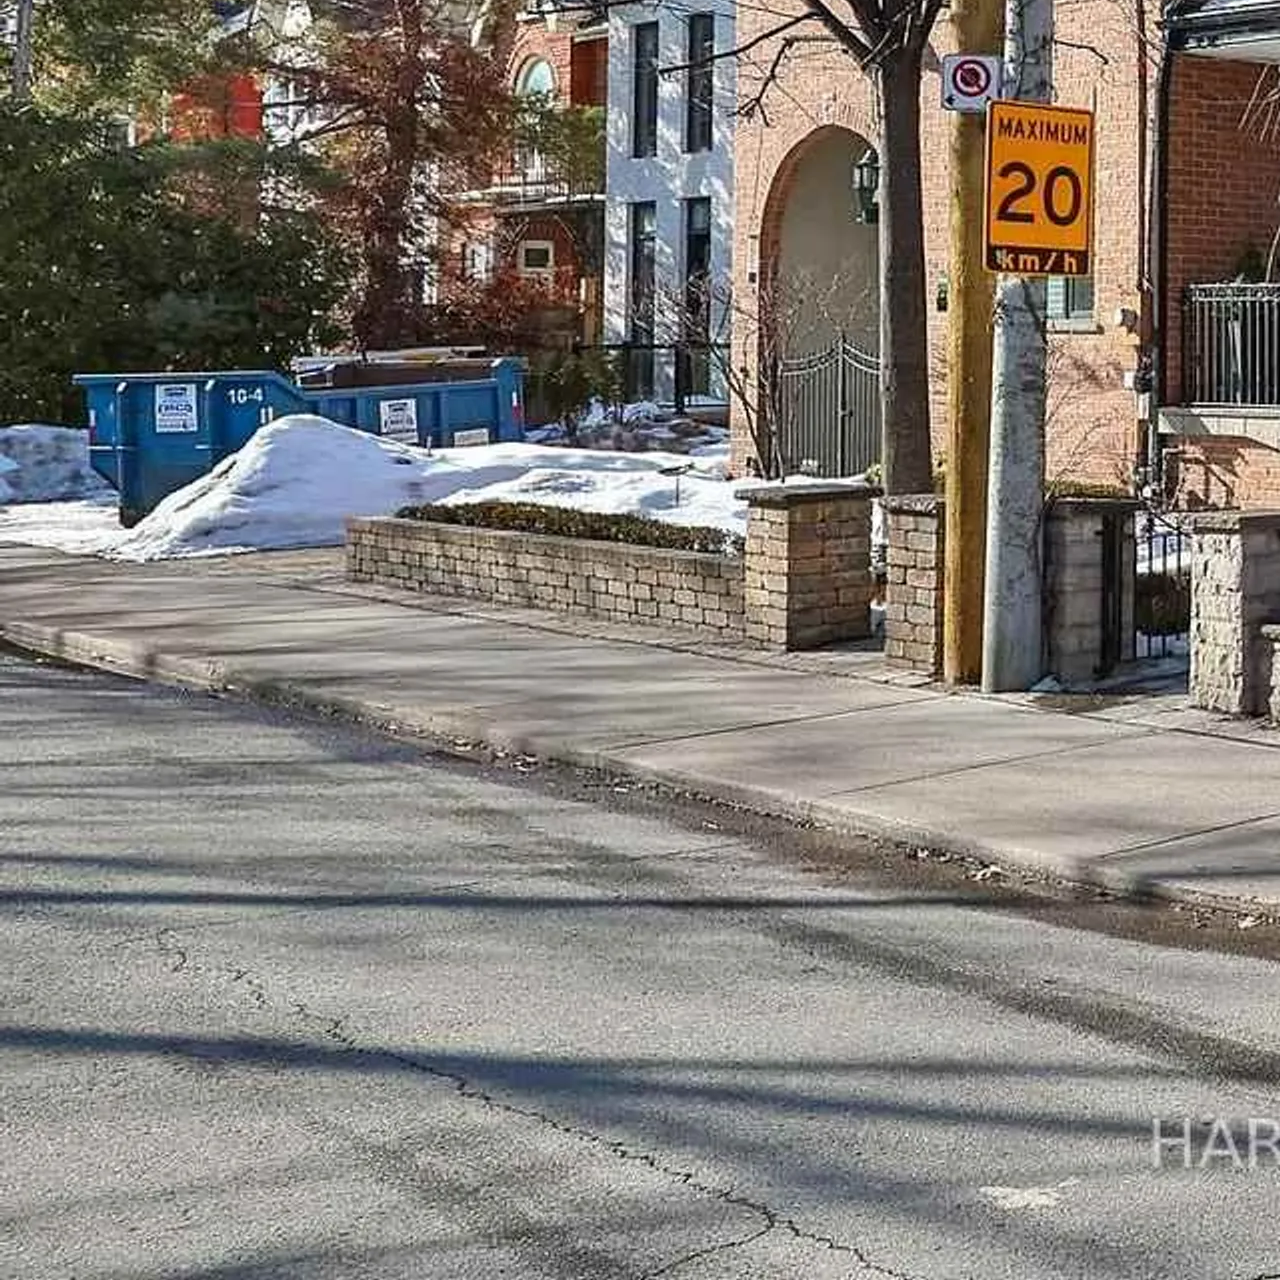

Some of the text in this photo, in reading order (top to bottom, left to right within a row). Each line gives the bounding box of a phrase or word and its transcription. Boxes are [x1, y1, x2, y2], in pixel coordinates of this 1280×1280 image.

[998, 117, 1088, 145] MAXIMUM
[997, 162, 1081, 226] 20
[1000, 250, 1077, 273] km/h
